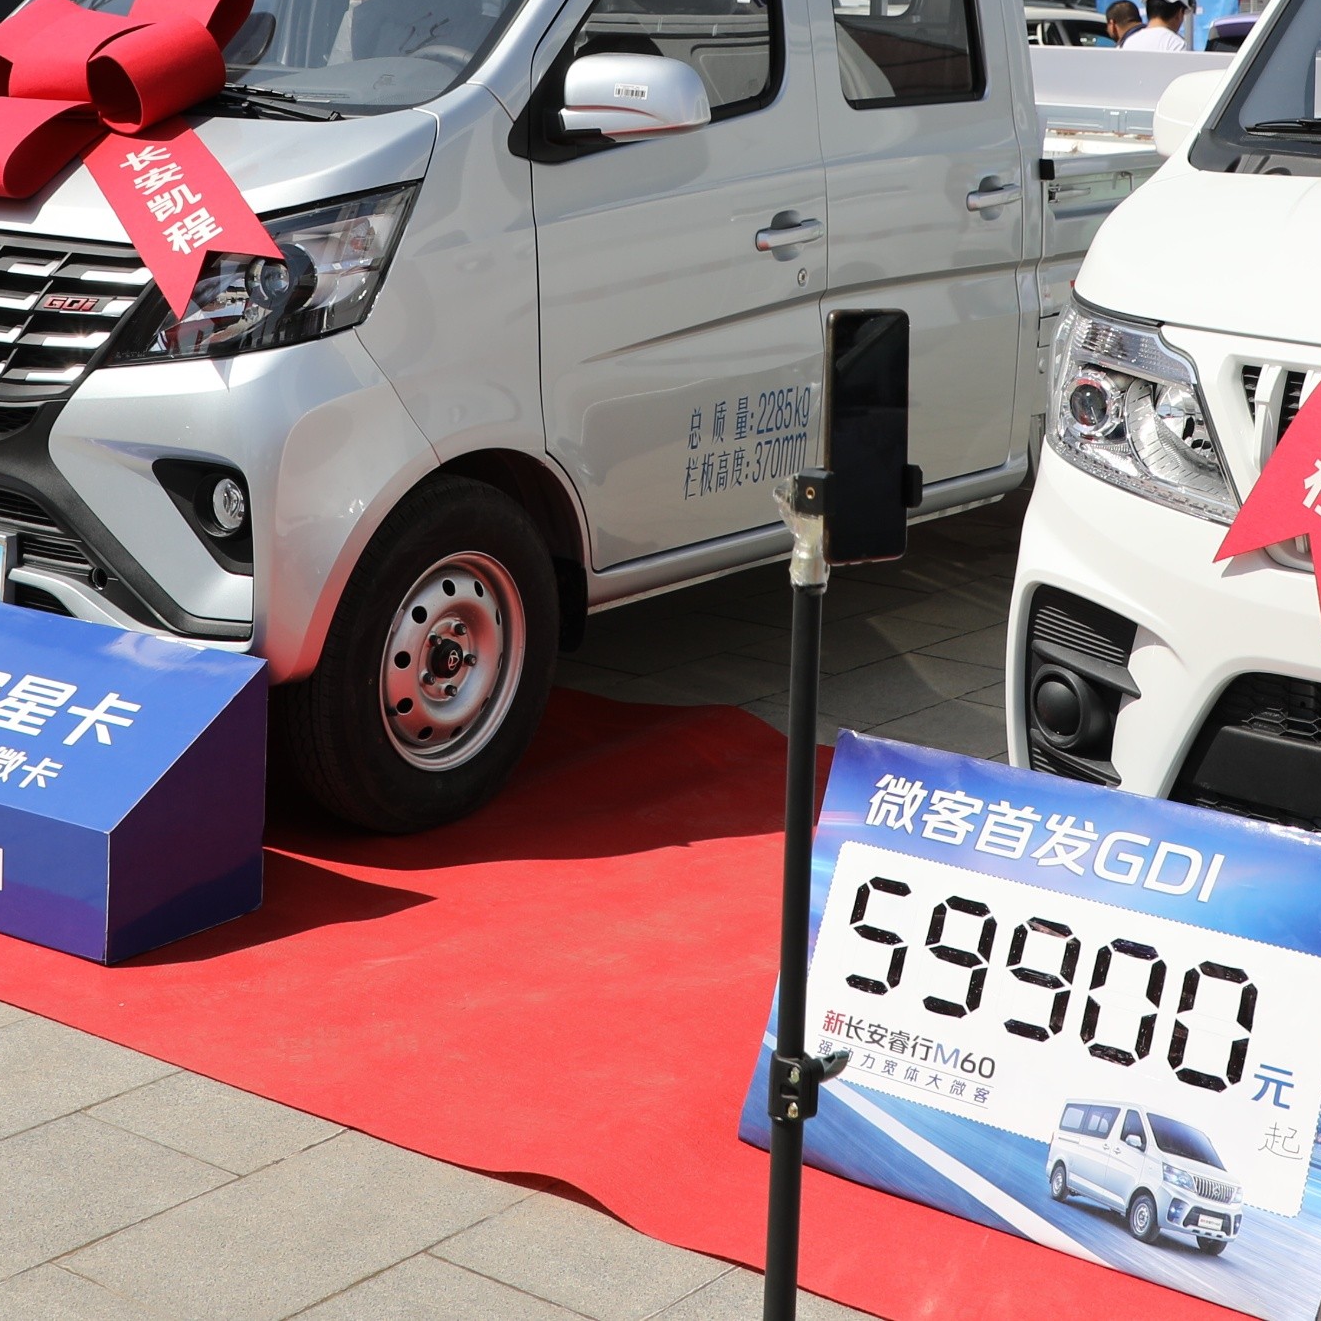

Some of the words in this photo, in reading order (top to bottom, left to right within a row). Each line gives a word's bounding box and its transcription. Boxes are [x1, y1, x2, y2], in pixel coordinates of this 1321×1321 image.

[119, 144, 224, 257] 长安凯程
[863, 771, 1225, 904] 微客首发GDI
[822, 1009, 996, 1079] 新长安睿行M60
